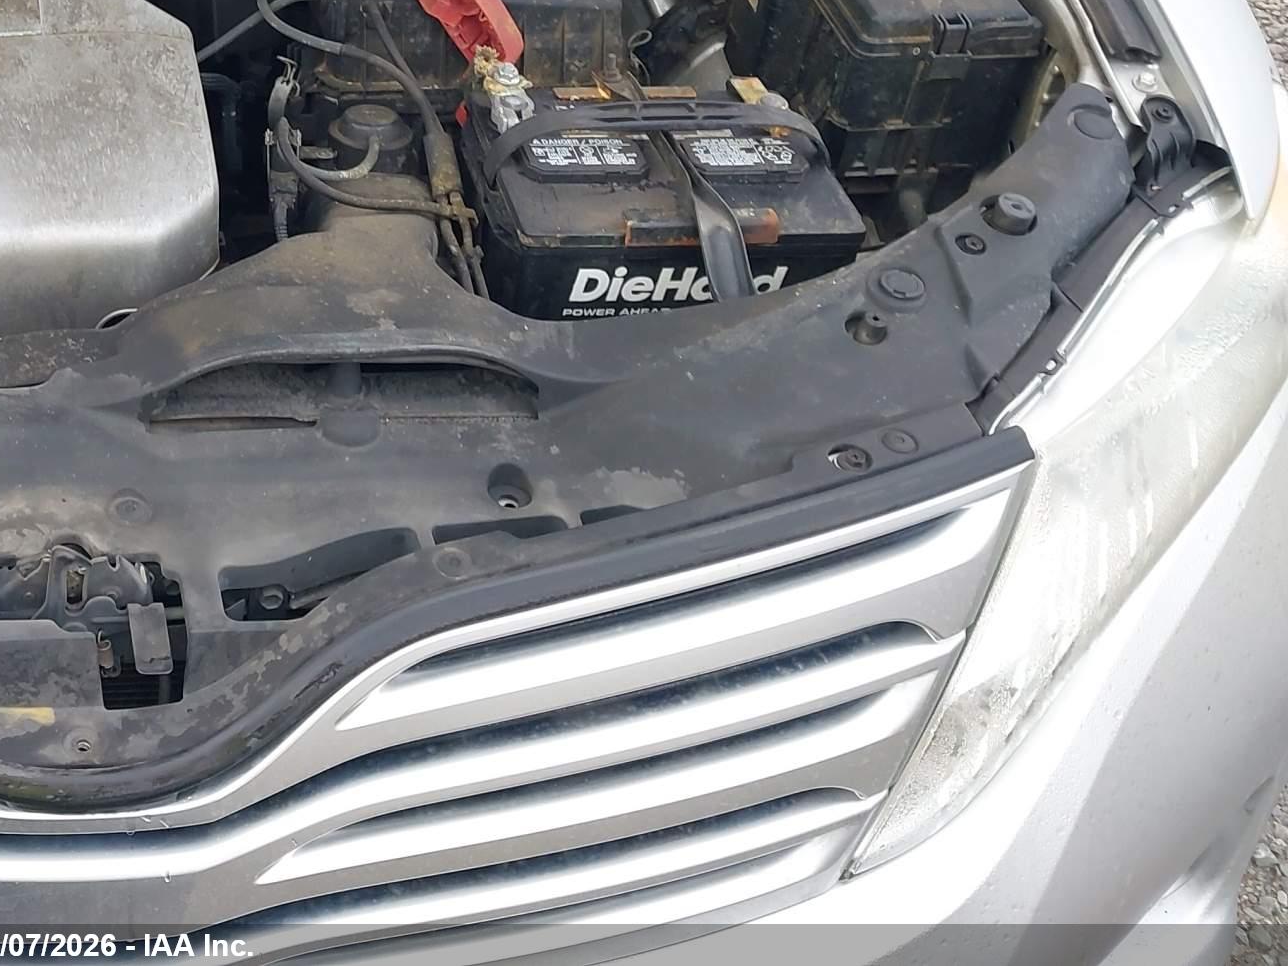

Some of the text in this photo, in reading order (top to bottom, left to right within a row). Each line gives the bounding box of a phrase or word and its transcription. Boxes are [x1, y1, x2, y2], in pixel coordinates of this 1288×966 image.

[588, 138, 623, 146] POISON
[569, 266, 789, 302] DieHad
[562, 307, 616, 317] POWER
